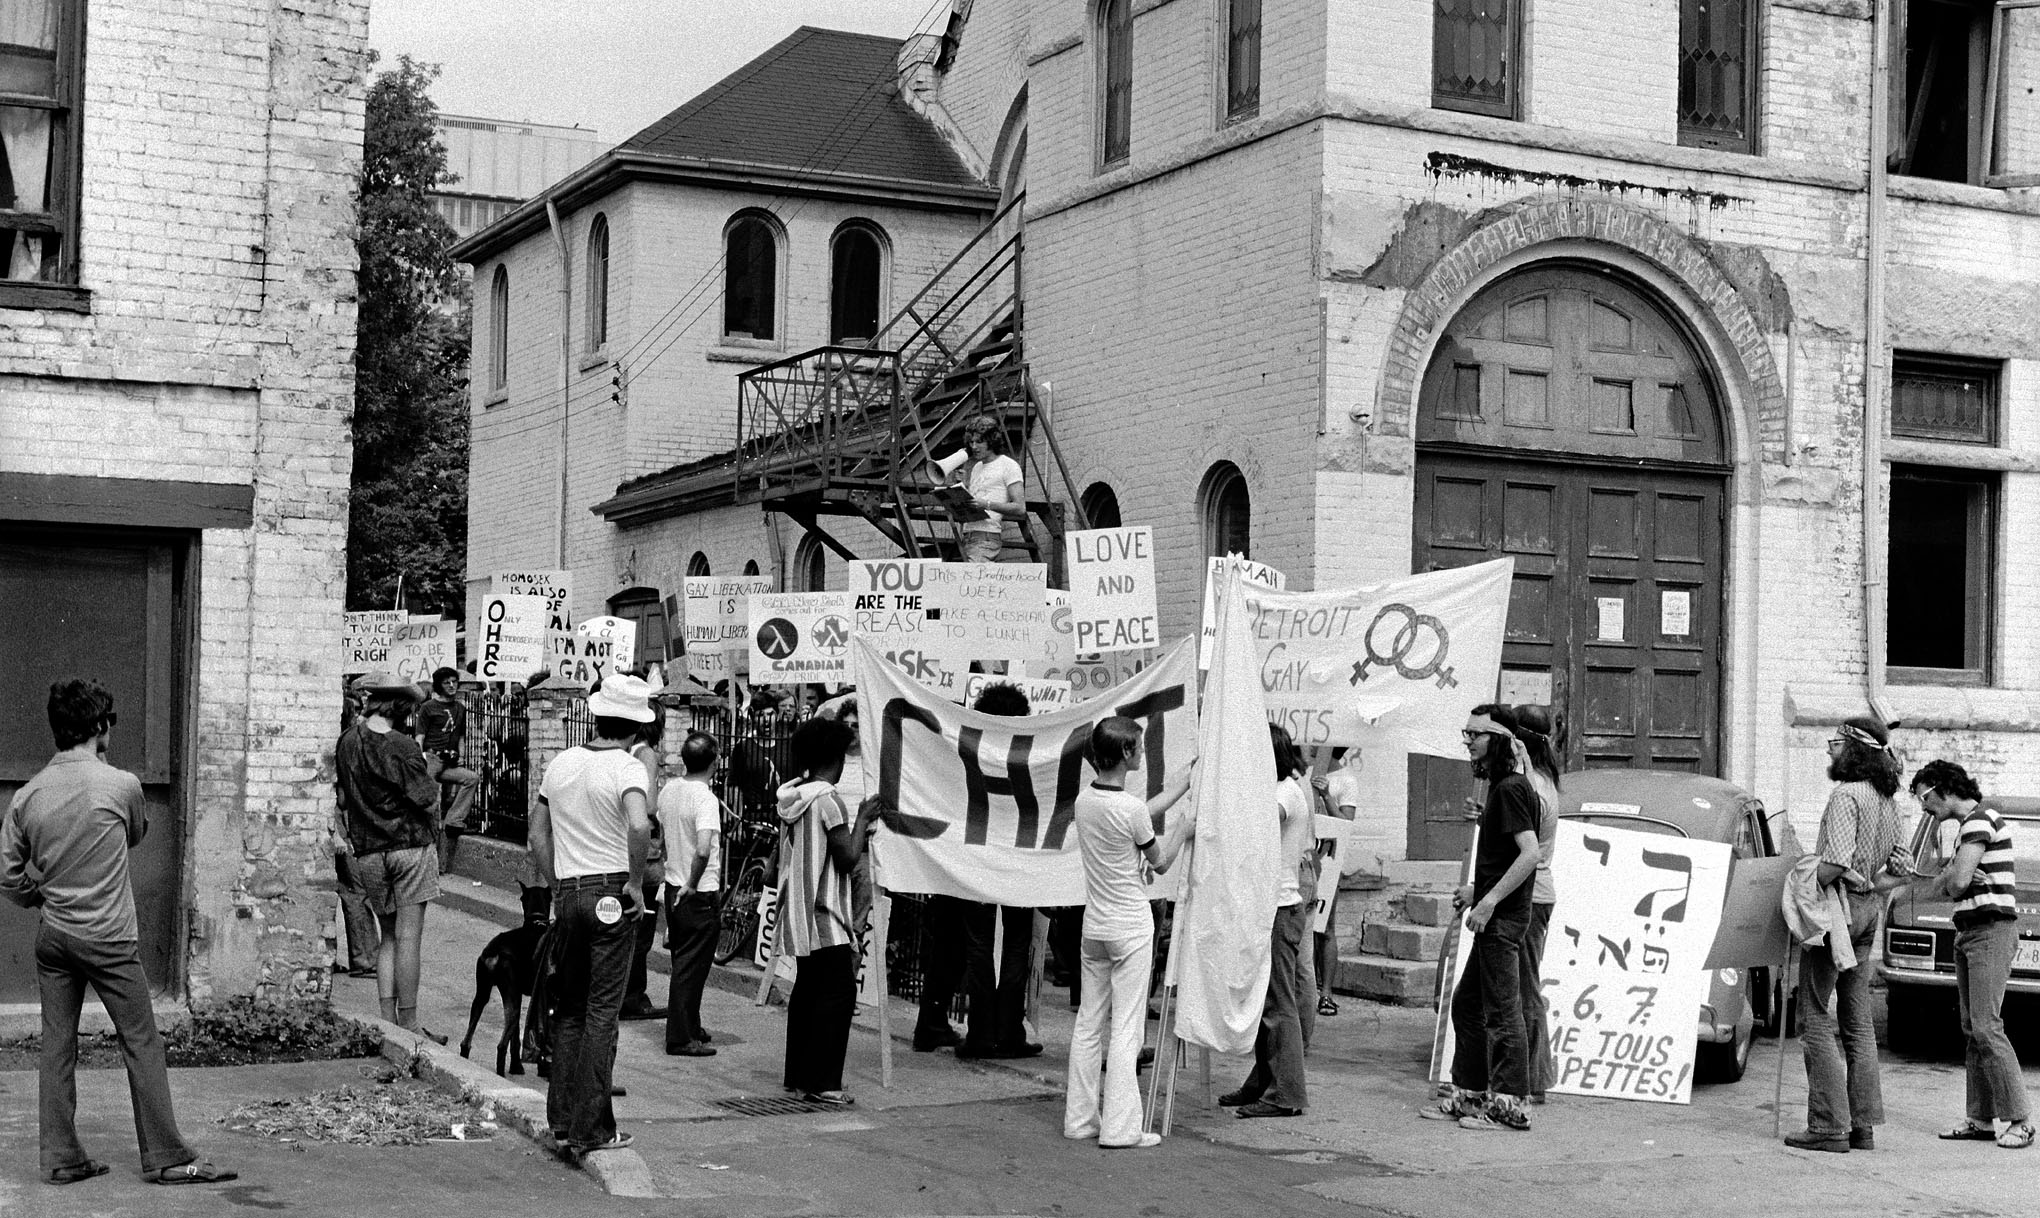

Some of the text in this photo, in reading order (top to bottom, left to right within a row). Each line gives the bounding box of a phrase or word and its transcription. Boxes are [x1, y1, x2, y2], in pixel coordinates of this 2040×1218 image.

[1075, 532, 1147, 563] LOVE
[502, 573, 550, 585] HOMOSEX
[865, 562, 924, 592] YOU
[928, 564, 1044, 583] This is Brotherhood
[510, 586, 567, 599] IS ALSO
[686, 582, 774, 596] GAY LIBERATION
[959, 584, 1008, 599] WEEK
[1097, 575, 1135, 596] AND
[718, 599, 736, 614] IS
[855, 595, 922, 610] ARE THE
[369, 612, 401, 622] THINK
[994, 609, 1046, 623] LESBIAN
[349, 623, 394, 634] TWICE
[396, 624, 438, 640] GLAD
[686, 625, 717, 640] HUMAN
[940, 624, 1030, 642] TO LUNCH
[1077, 616, 1154, 649] PEACE
[354, 649, 391, 661] RIGH
[405, 643, 445, 656] TO BE
[554, 637, 576, 656] I'M
[584, 640, 613, 658] NOT
[397, 657, 443, 679] GAY
[559, 659, 605, 682] GAY
[772, 660, 845, 671] CANADIAN
[1261, 642, 1309, 692] GAY
[1031, 686, 1067, 703] WHAT
[1599, 1031, 1674, 1067] TOUS
